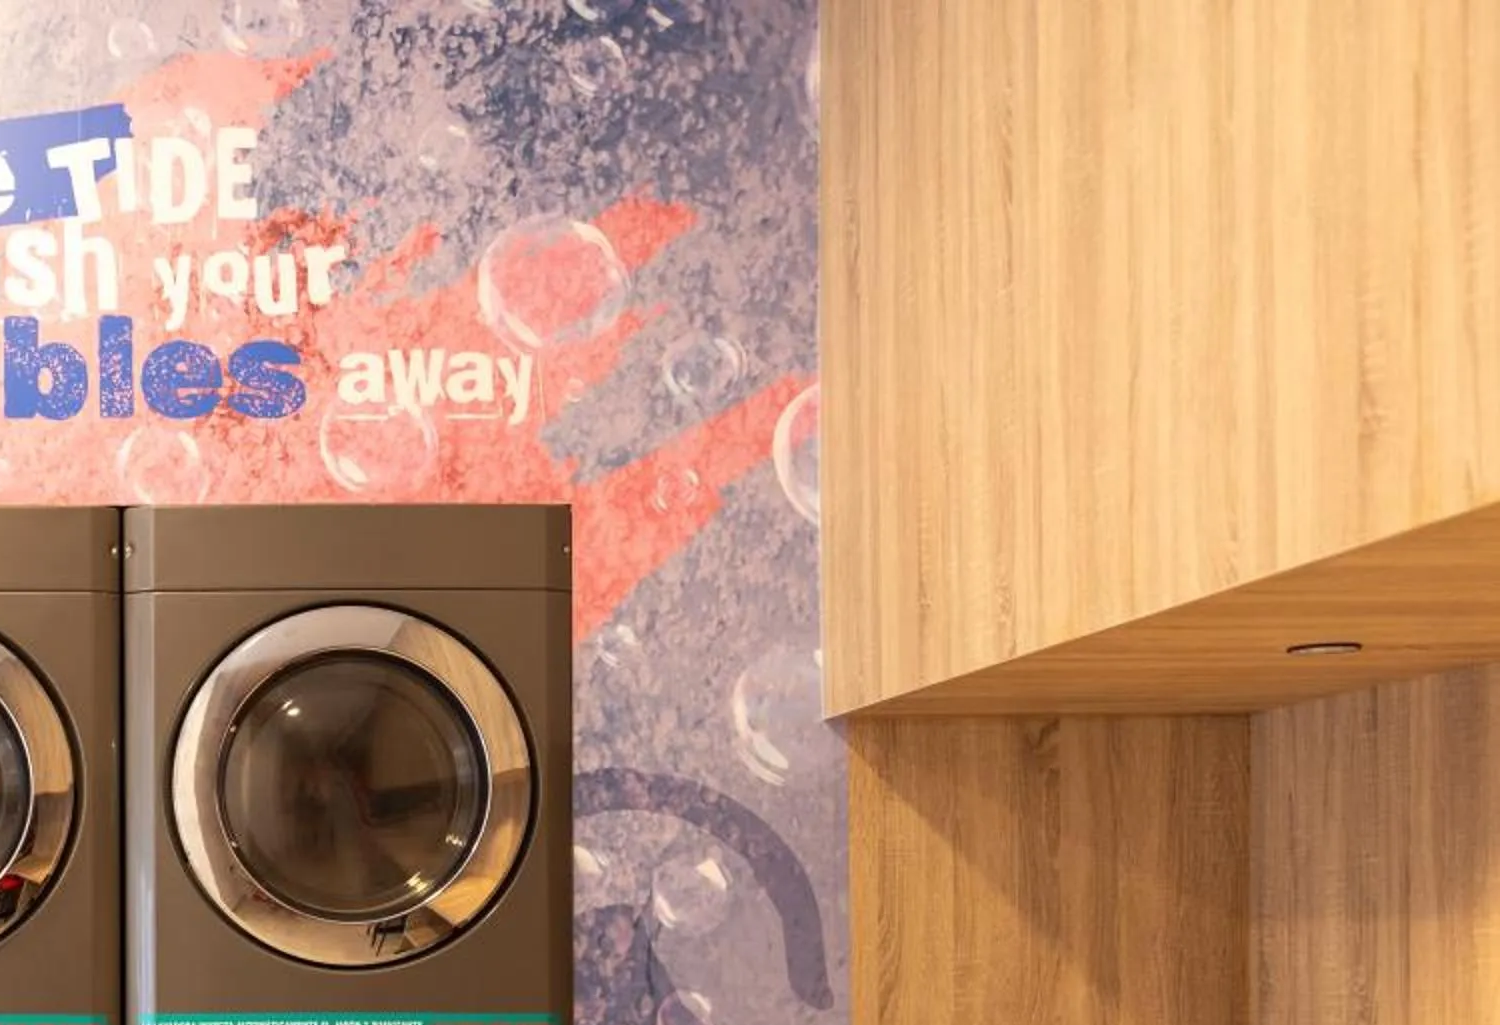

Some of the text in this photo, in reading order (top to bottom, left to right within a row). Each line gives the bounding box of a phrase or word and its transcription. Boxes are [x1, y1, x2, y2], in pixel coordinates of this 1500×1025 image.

[47, 127, 258, 226] TIDE
[154, 242, 348, 332] your
[337, 346, 534, 425] away
